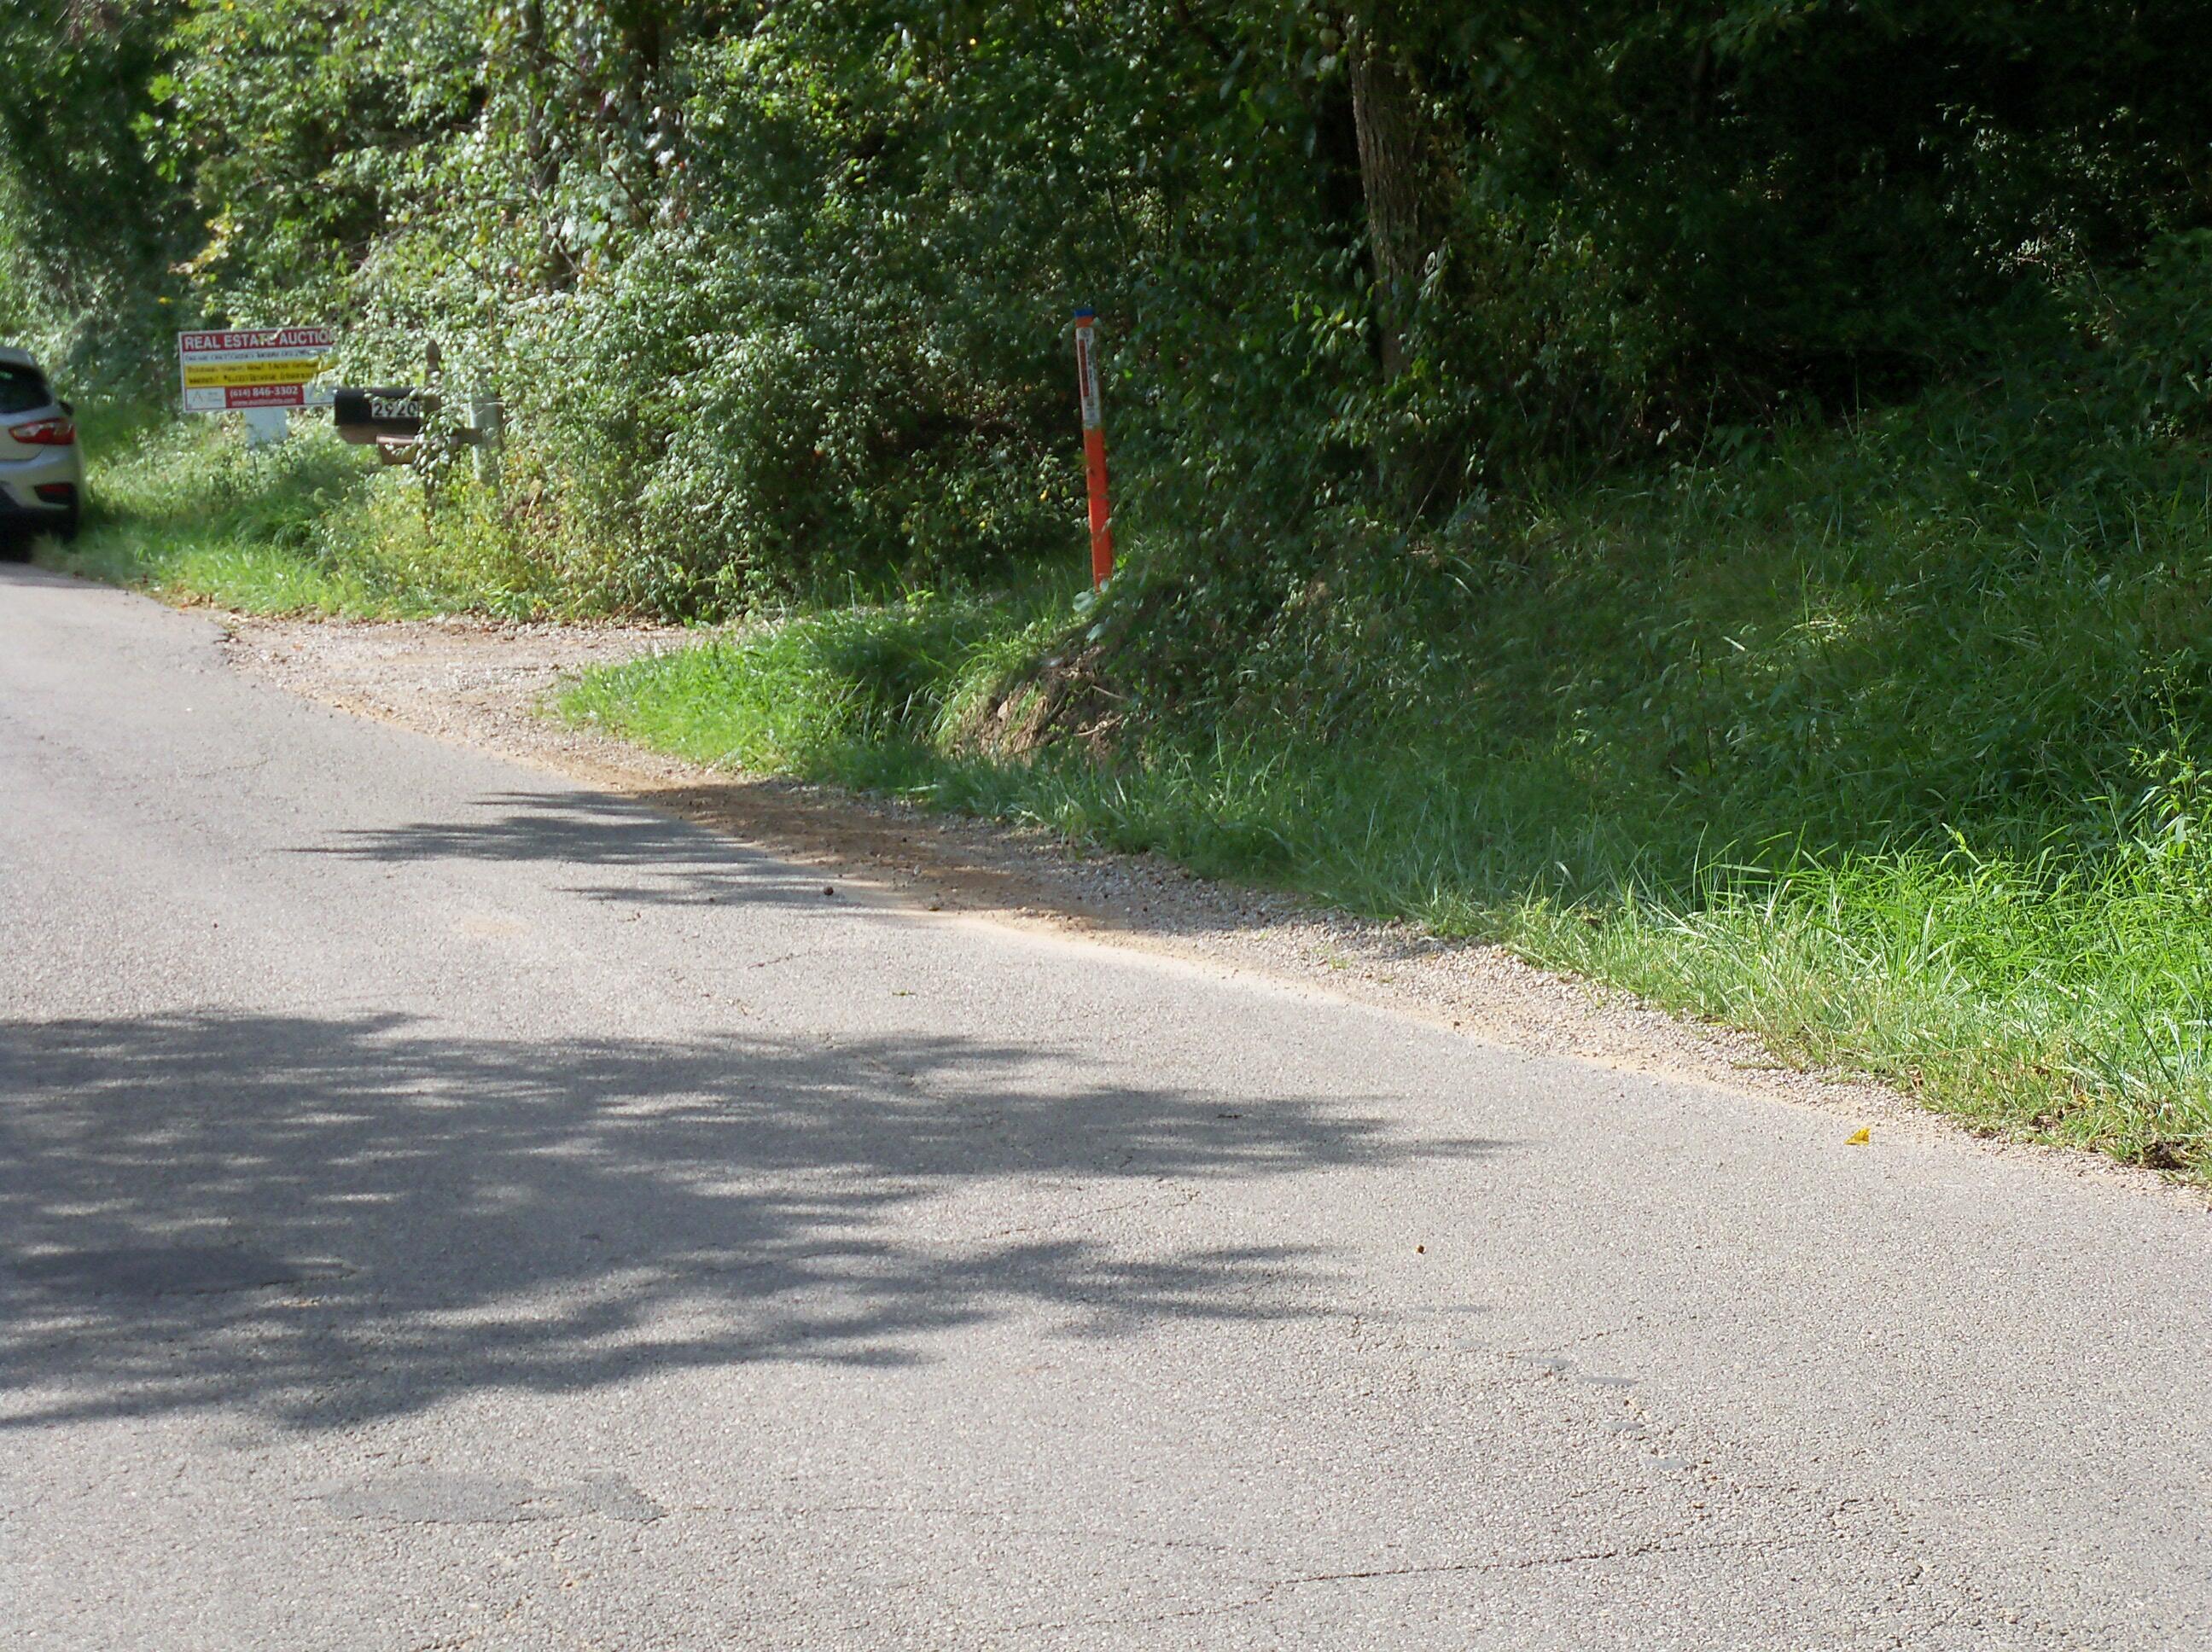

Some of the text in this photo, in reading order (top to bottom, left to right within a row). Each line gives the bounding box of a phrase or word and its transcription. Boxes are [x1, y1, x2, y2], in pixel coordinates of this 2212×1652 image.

[184, 335, 221, 350] REAL
[224, 332, 275, 347] ESTATE
[252, 386, 299, 397] 846-3302
